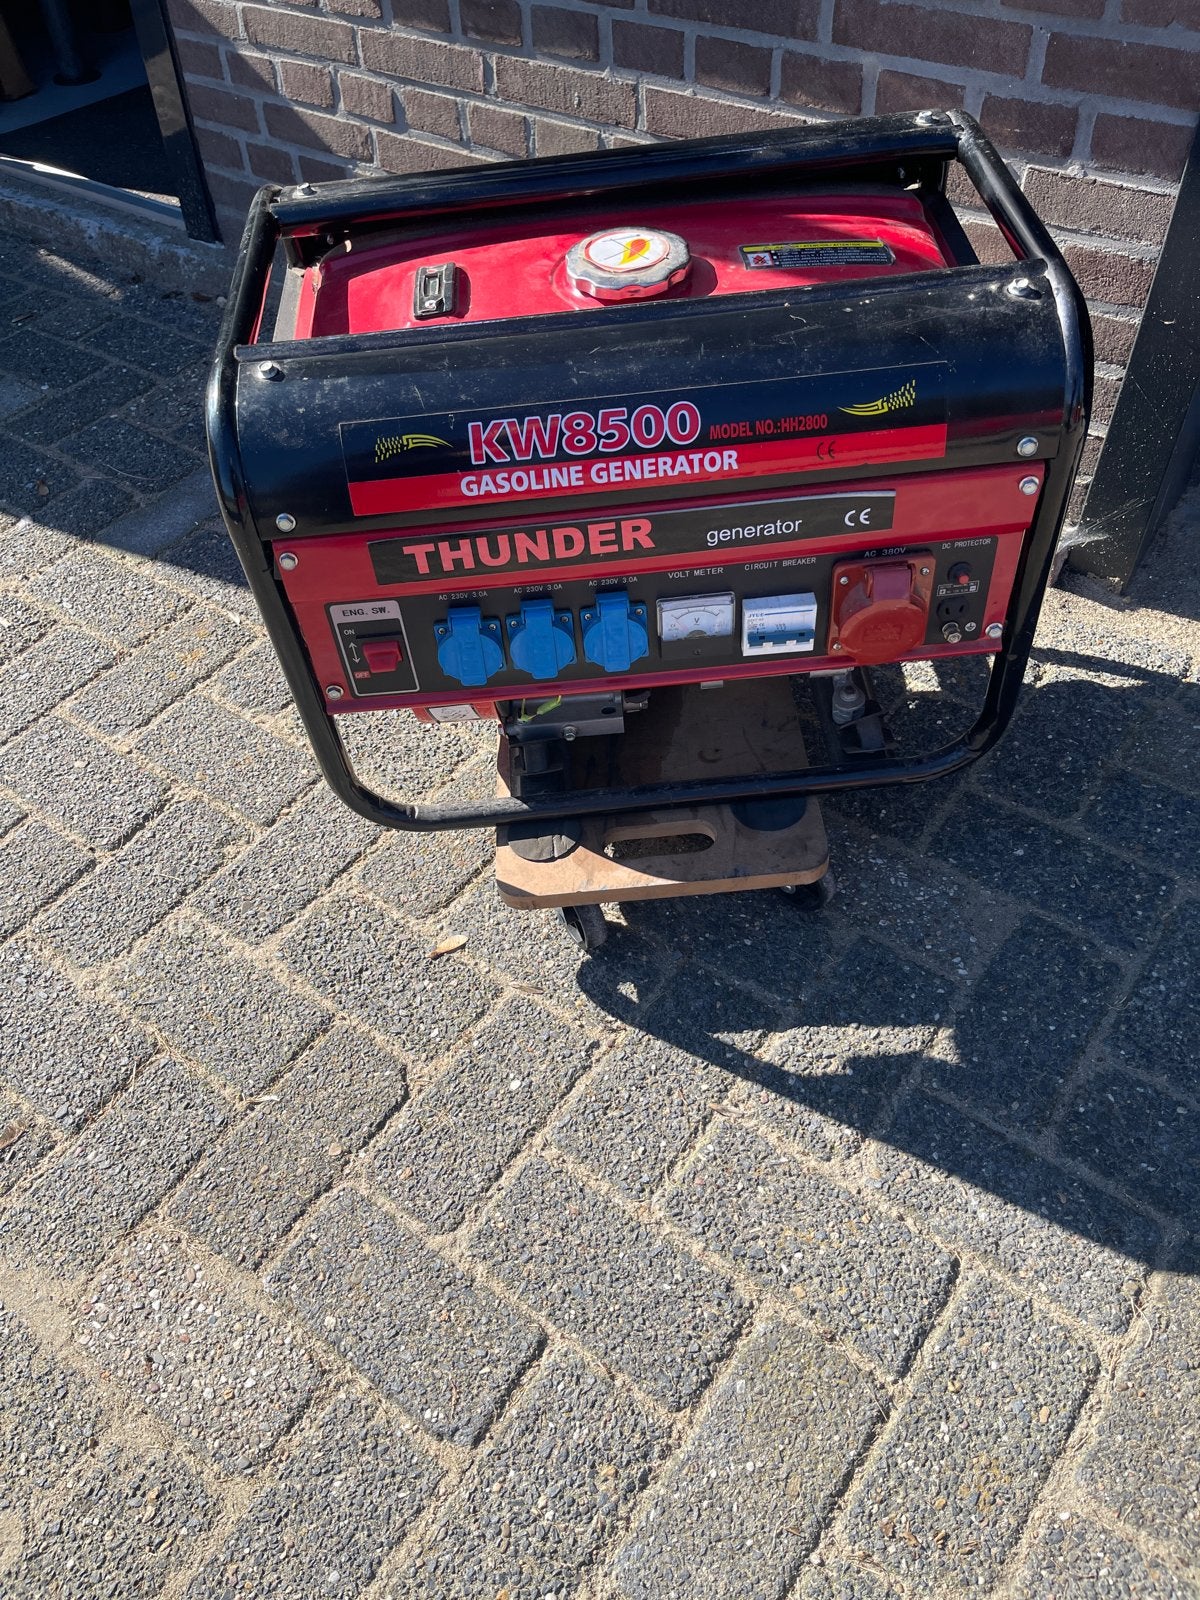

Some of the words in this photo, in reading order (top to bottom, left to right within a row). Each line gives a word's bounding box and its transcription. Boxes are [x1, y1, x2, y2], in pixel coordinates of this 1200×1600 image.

[467, 402, 701, 464] KW8500
[709, 420, 754, 440] MODEL
[756, 414, 828, 436] NO.:HH2800
[460, 465, 584, 497] GASOLINE
[591, 450, 739, 483] GENERATOR
[705, 517, 803, 546] generator
[402, 518, 656, 574] THUNDER
[954, 538, 992, 548] PROTECTOR
[882, 548, 906, 556] 380V
[744, 561, 777, 571] CIRCUIT
[782, 557, 816, 567] BREAKER
[668, 571, 690, 579] VOLT
[694, 567, 724, 577] METER
[601, 578, 618, 586] 230V
[342, 608, 369, 617] ENG.
[371, 606, 390, 615] SW.
